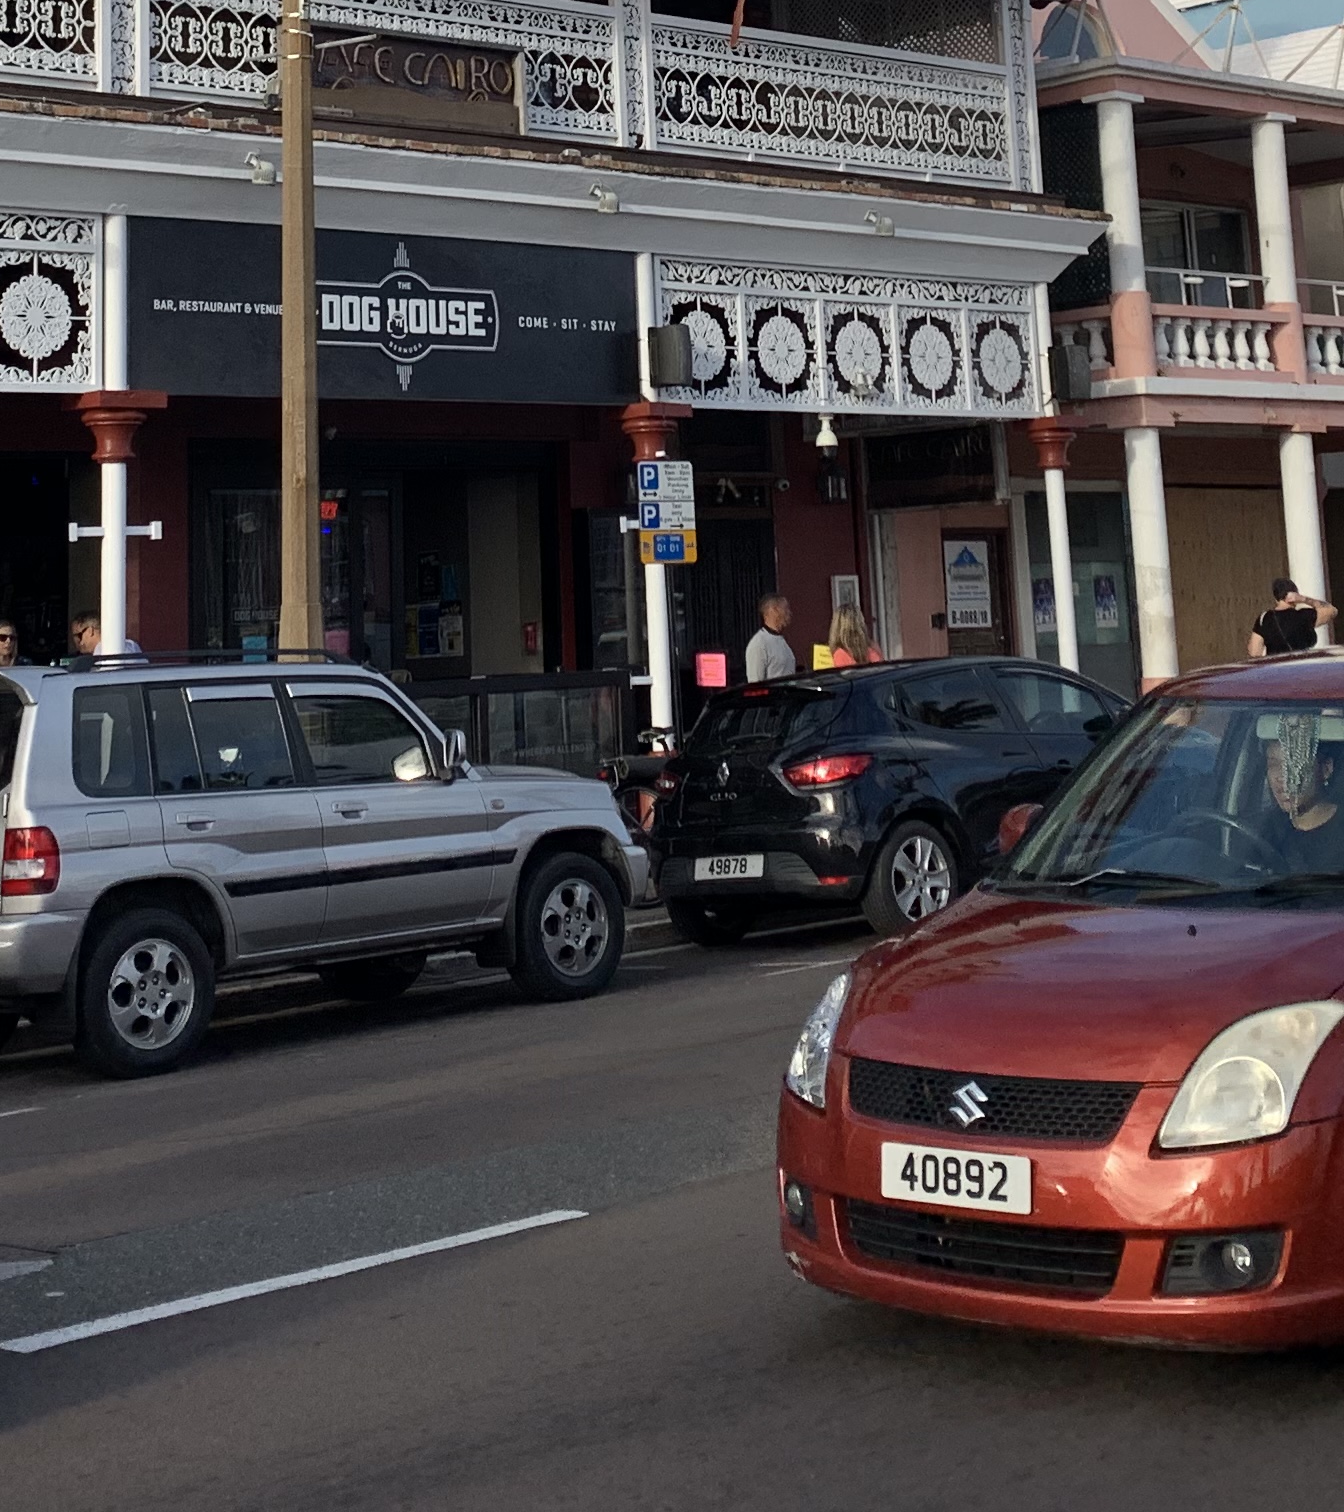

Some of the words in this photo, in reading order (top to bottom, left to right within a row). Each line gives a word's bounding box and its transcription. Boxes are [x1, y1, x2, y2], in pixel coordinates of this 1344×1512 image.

[316, 41, 395, 84] AFE
[404, 52, 513, 94] CAIRO
[397, 281, 412, 290] THE
[153, 299, 177, 312] BAR,
[178, 300, 243, 313] RESTAURANT
[244, 304, 253, 314] &
[321, 293, 381, 332] DOG
[386, 298, 487, 337] HOUSE
[518, 316, 549, 329] COME
[561, 318, 579, 330] SIT
[590, 320, 616, 332] STAY
[643, 467, 655, 488] P
[644, 505, 657, 527] P
[709, 792, 738, 801] CLIO
[708, 857, 748, 876] 49878
[900, 1152, 1008, 1203] 40892
